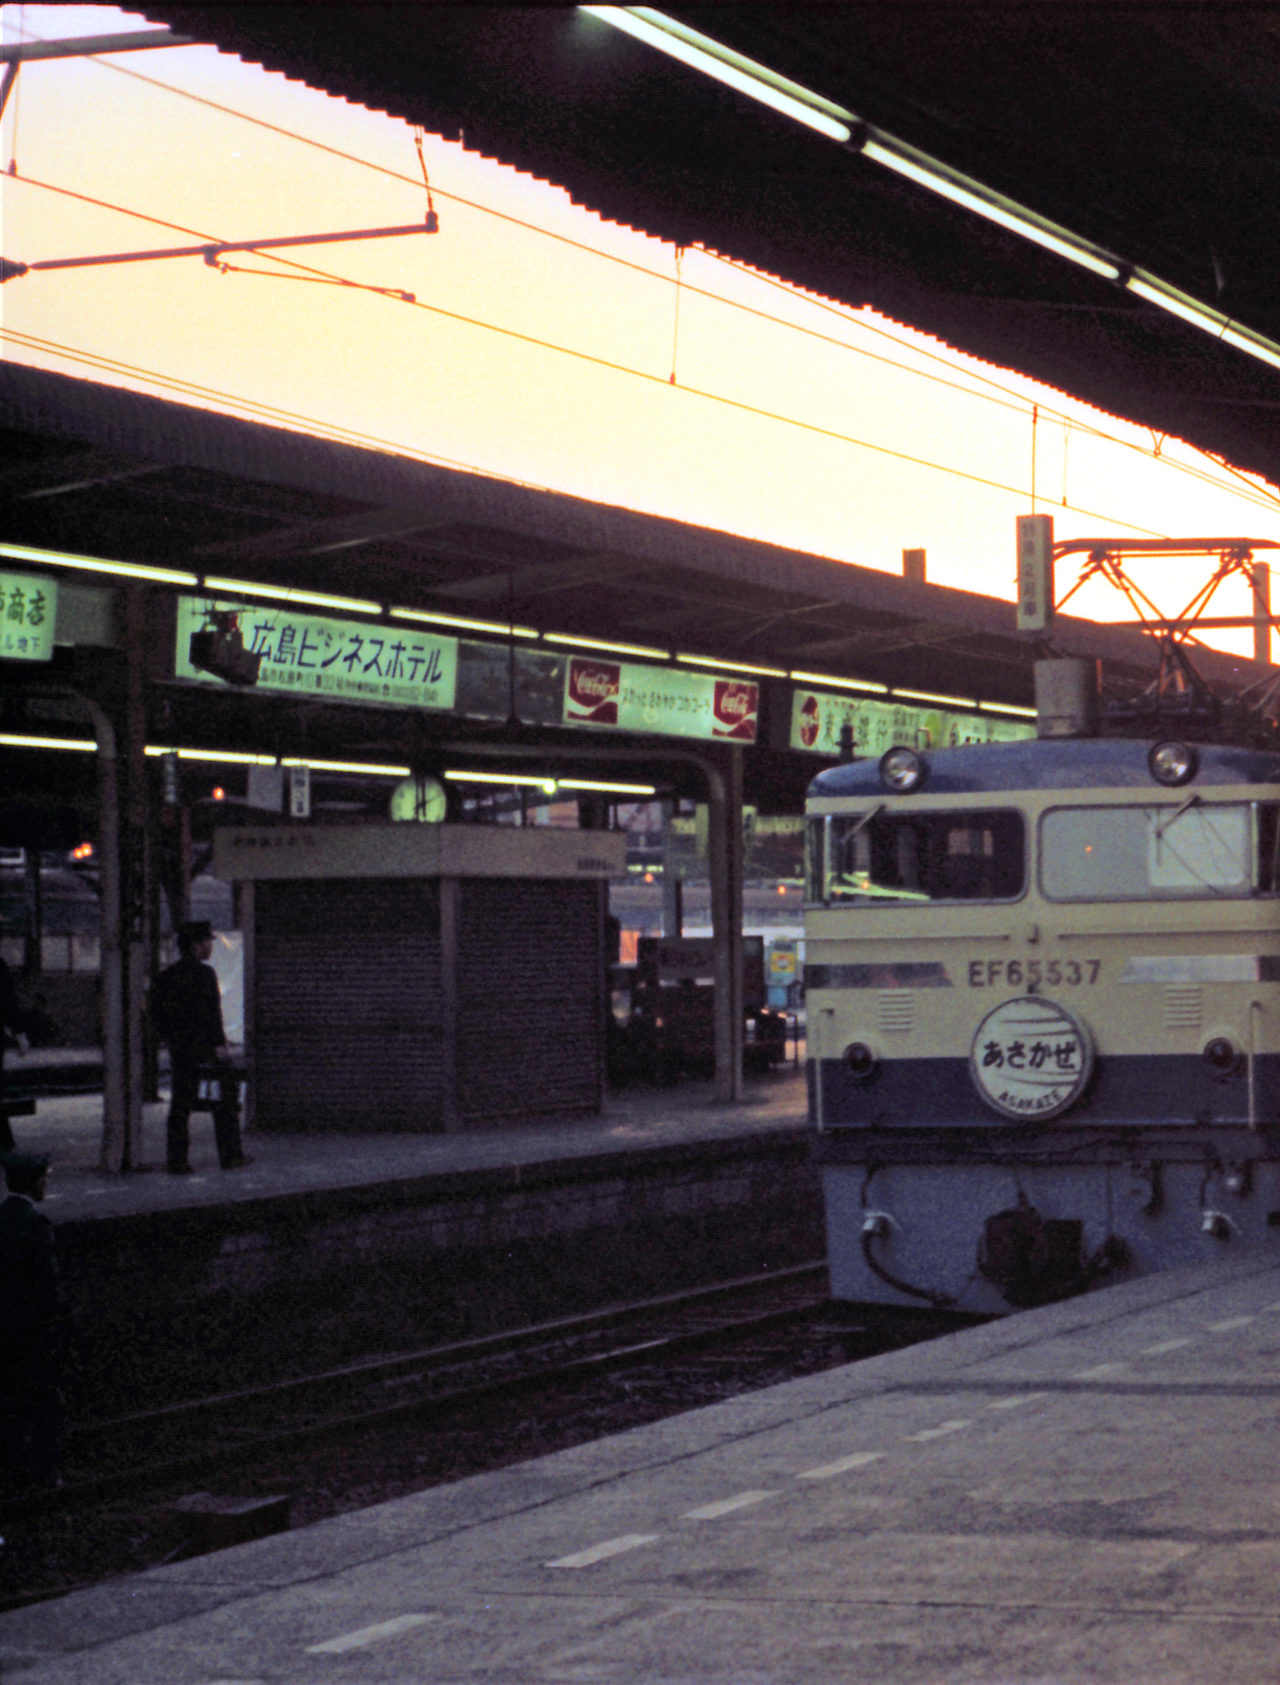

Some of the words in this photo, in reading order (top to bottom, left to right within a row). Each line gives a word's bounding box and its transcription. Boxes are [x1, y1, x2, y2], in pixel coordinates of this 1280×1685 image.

[251, 620, 443, 684] 広島ビジネスホテル
[967, 959, 1102, 988] EF65537
[983, 1041, 1077, 1069] あさかぜ
